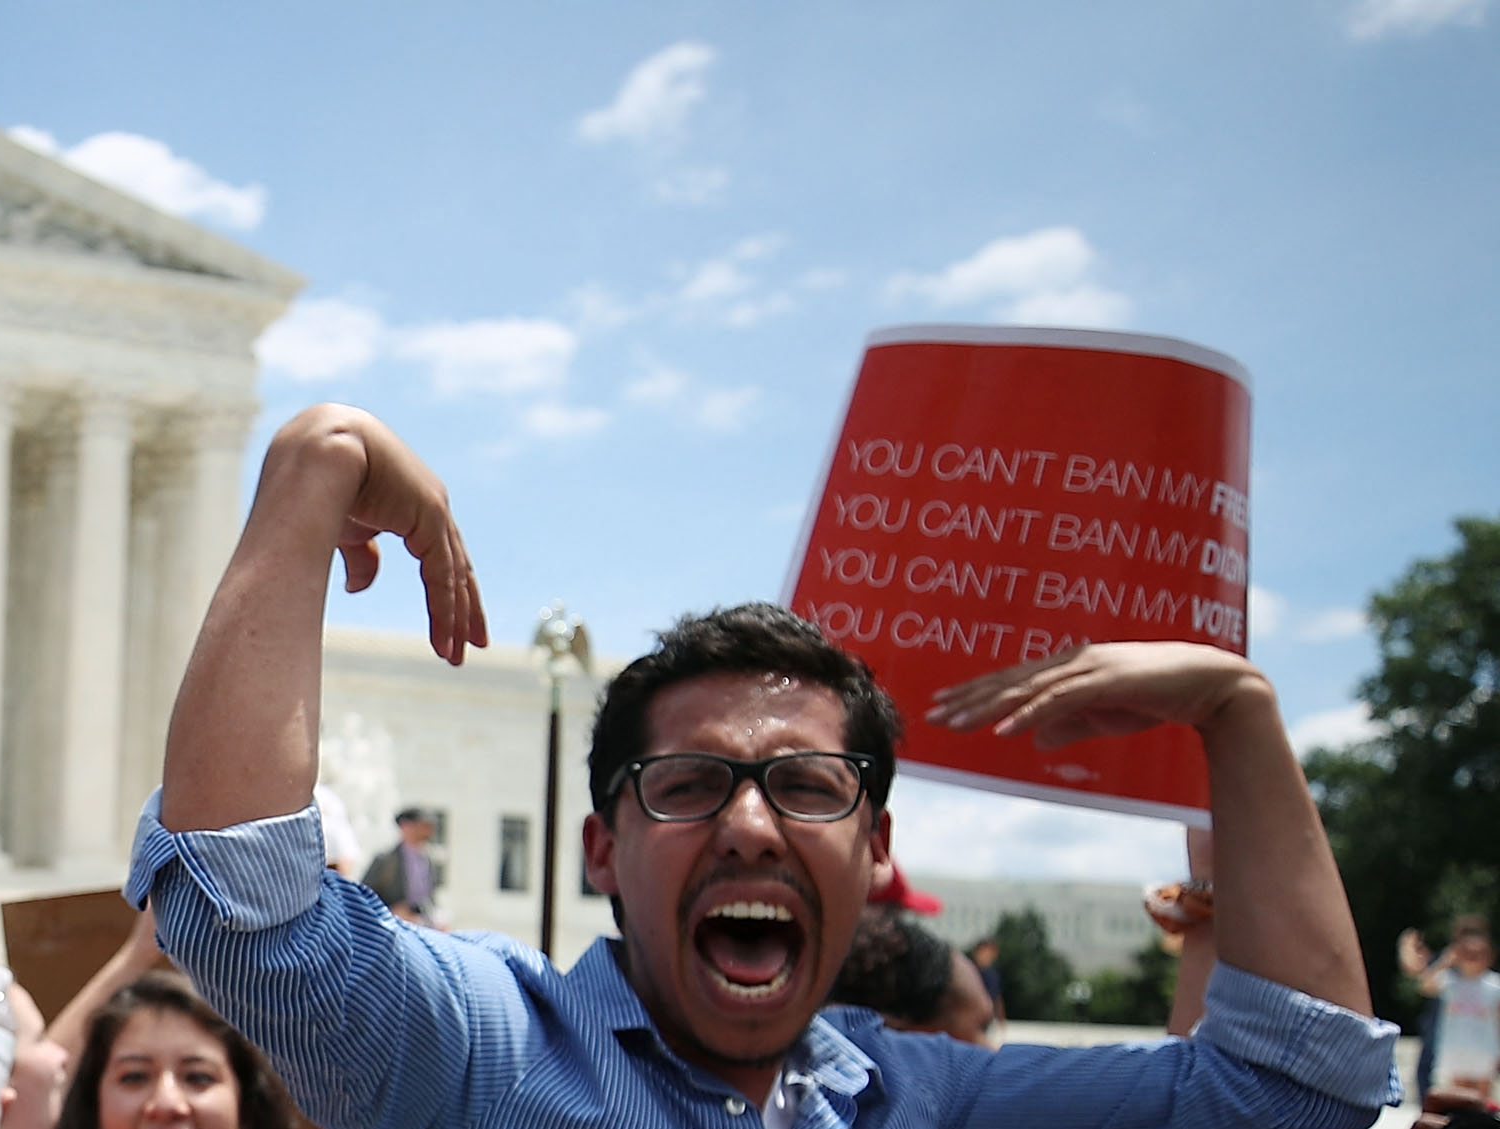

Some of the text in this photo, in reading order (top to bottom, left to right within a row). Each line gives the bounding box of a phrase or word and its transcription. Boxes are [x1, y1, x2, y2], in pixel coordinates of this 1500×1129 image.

[849, 438, 924, 479] YOU
[931, 444, 1057, 487] CAN'T
[1063, 455, 1155, 501] BAN
[1159, 473, 1208, 507] MY
[833, 493, 911, 533] YOU
[917, 500, 1043, 544] CAN'T
[1048, 513, 1138, 560] BAN
[1144, 526, 1198, 570] MY
[806, 601, 884, 643] YOU
[890, 611, 1015, 659] CAN'T
[819, 547, 1243, 645] YOU CAN'T BAN MY VOTE
